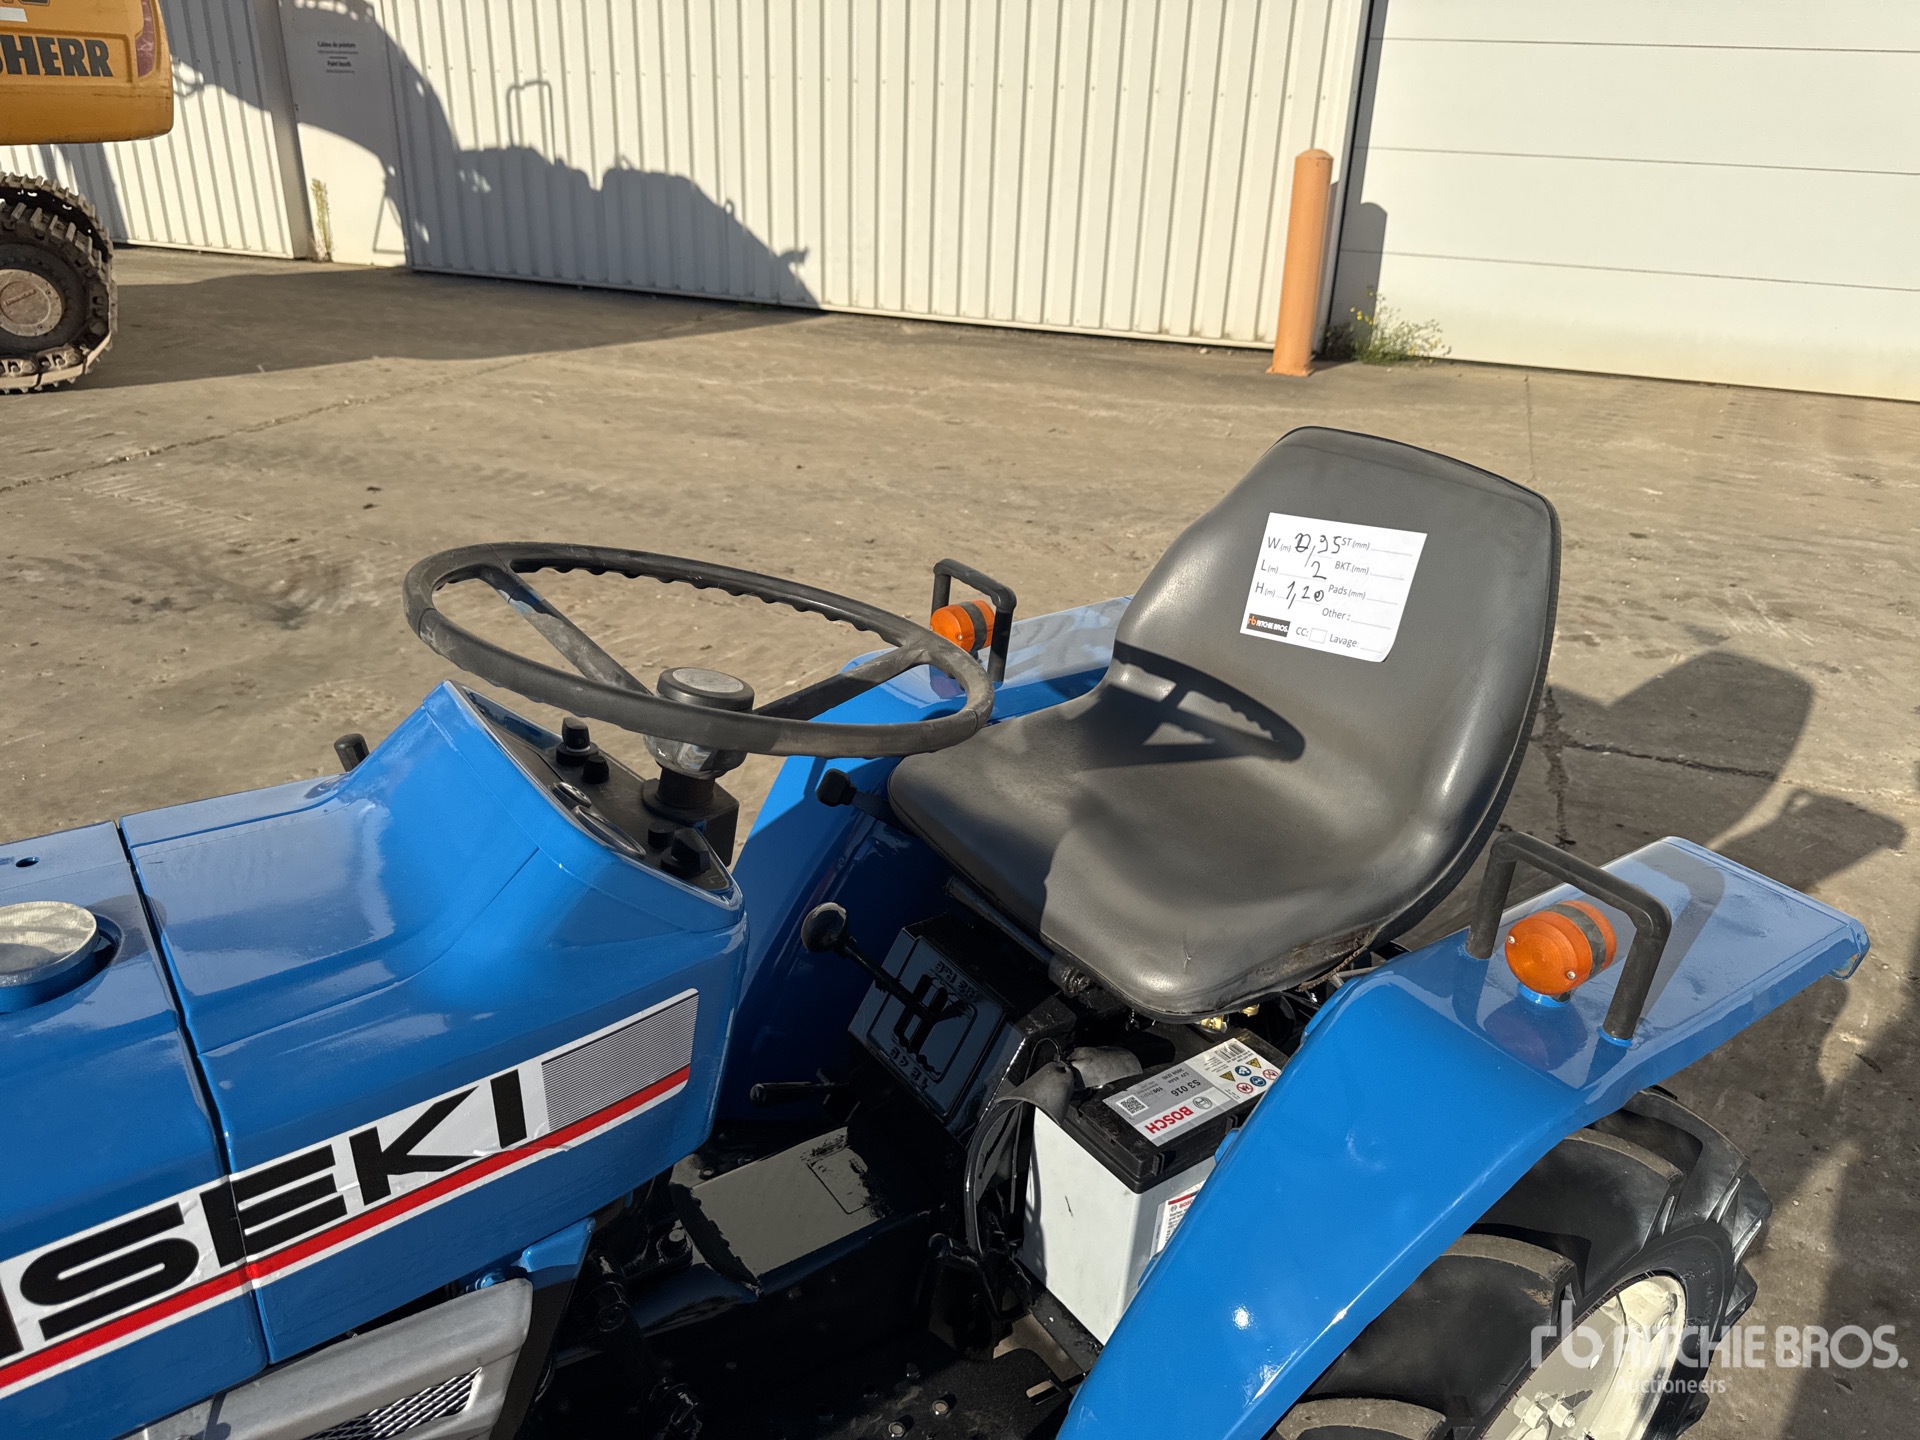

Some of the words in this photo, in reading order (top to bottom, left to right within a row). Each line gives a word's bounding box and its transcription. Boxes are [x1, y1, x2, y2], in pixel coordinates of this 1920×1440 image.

[1311, 560, 1328, 580] 2
[1170, 1085, 1189, 1097] 016
[1144, 1106, 1194, 1134] BOSCH
